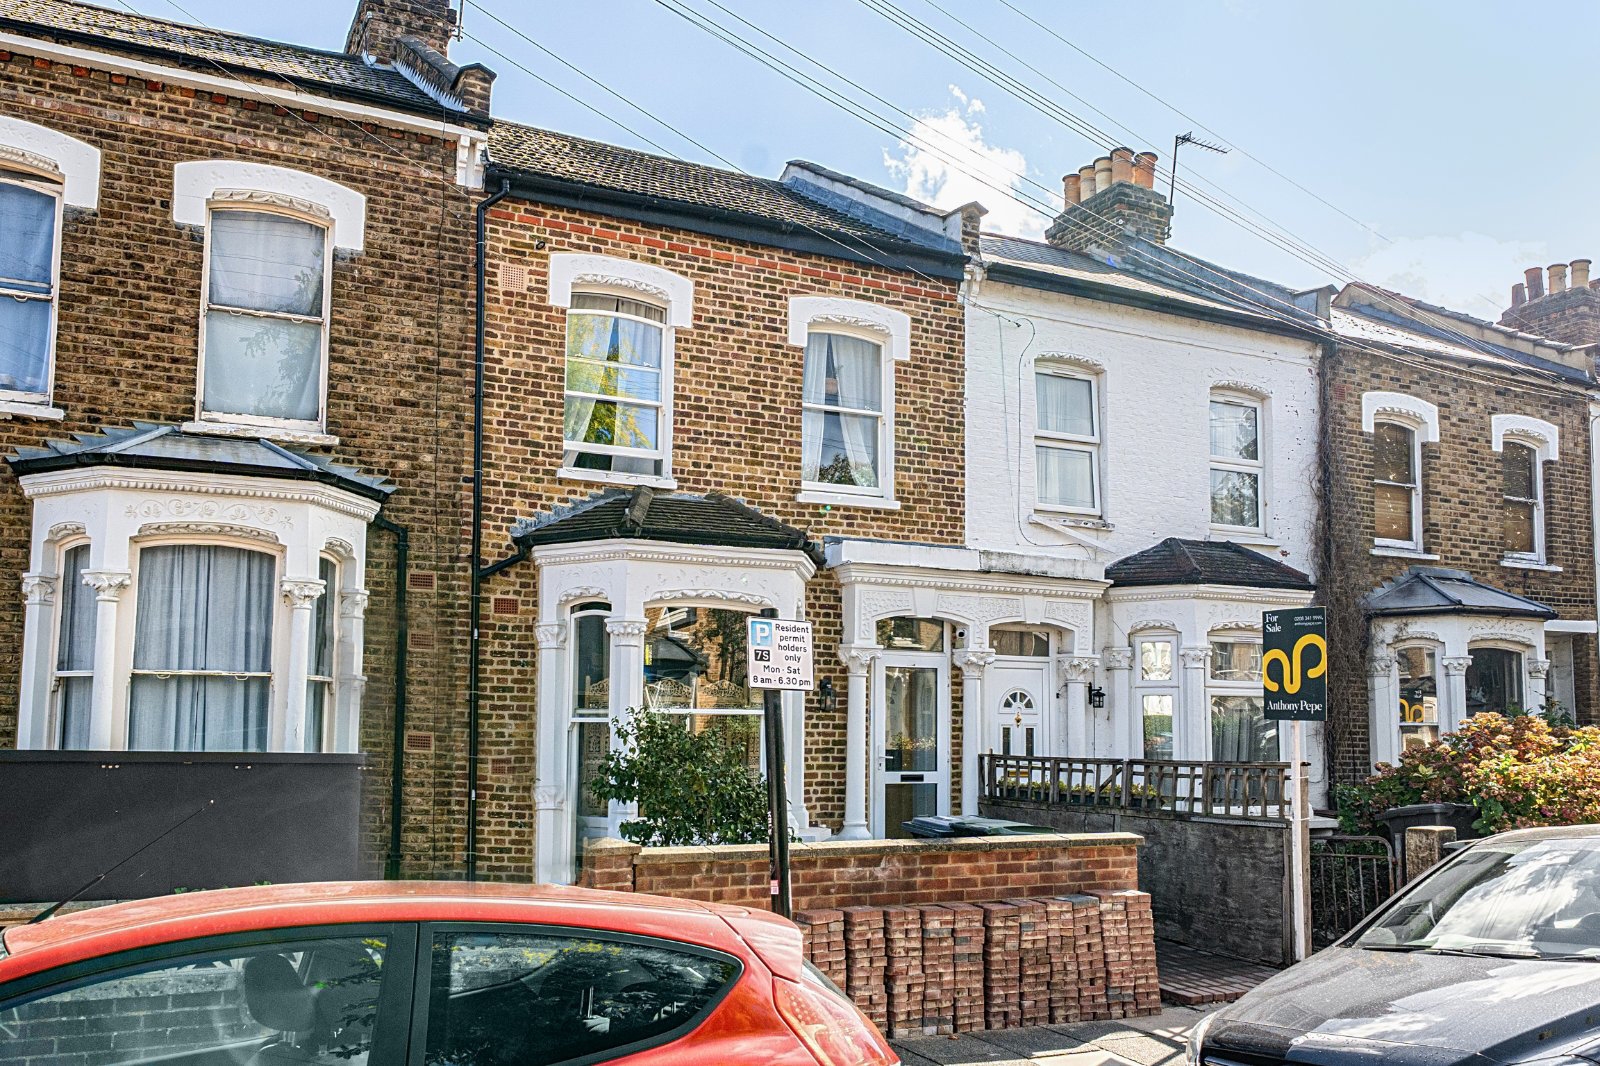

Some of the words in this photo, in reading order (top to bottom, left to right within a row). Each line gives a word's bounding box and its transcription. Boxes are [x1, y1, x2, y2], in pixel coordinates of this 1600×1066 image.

[1266, 613, 1279, 622] For
[775, 623, 809, 633] Resident
[1265, 623, 1282, 632] Sale
[756, 624, 769, 645] P
[779, 634, 805, 643] permit
[778, 643, 807, 653] holders
[755, 651, 769, 660] 7S
[784, 654, 801, 663] only
[763, 665, 780, 673] Mon
[786, 666, 800, 675] Sat
[753, 675, 758, 683] 8
[778, 677, 797, 685] 6.30
[1267, 700, 1299, 713] Anthony
[1300, 700, 1323, 714] Pepe
